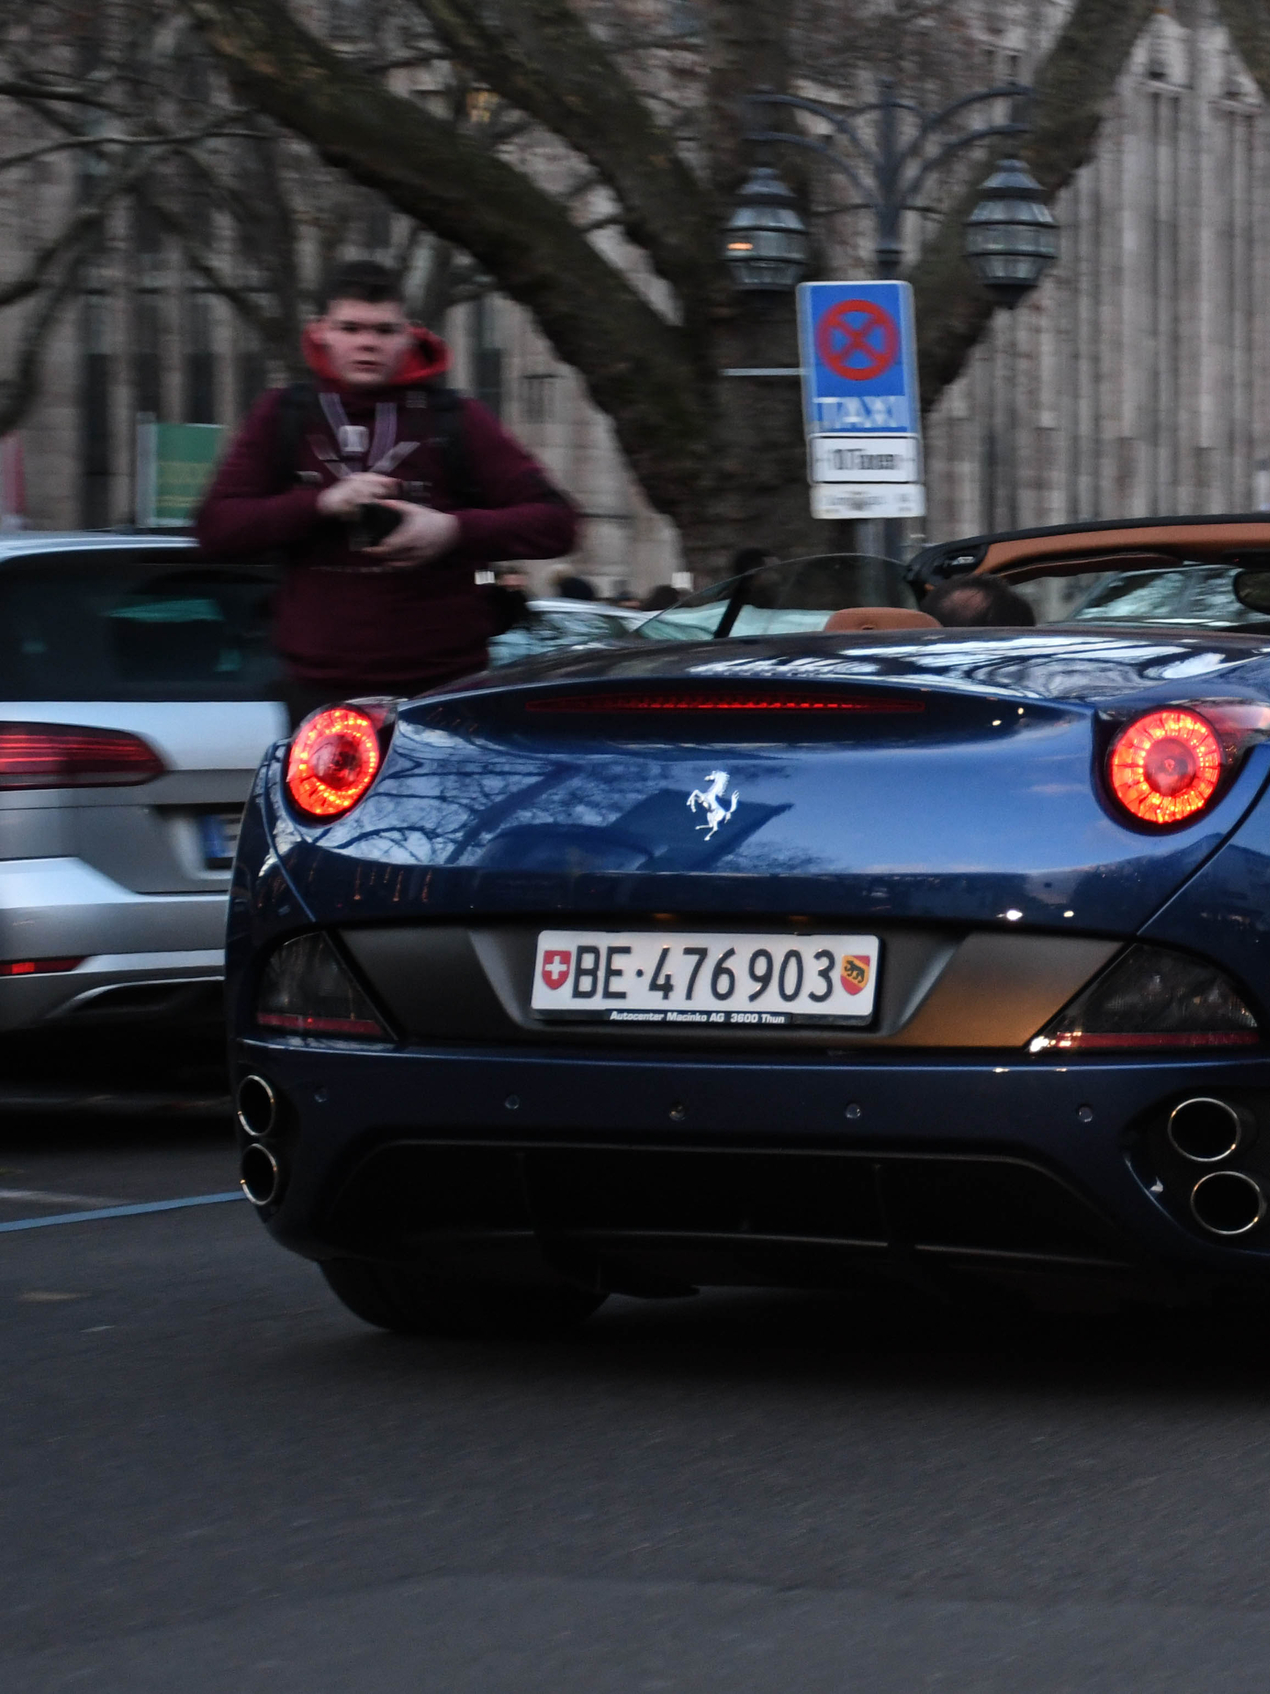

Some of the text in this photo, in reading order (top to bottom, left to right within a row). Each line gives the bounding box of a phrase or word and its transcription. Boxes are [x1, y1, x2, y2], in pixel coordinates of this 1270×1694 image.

[814, 397, 906, 428] TAXI
[610, 1011, 664, 1021] Autocenter
[709, 1013, 725, 1022] AG
[730, 1013, 758, 1023] 3600
[761, 1014, 785, 1023] Thun
